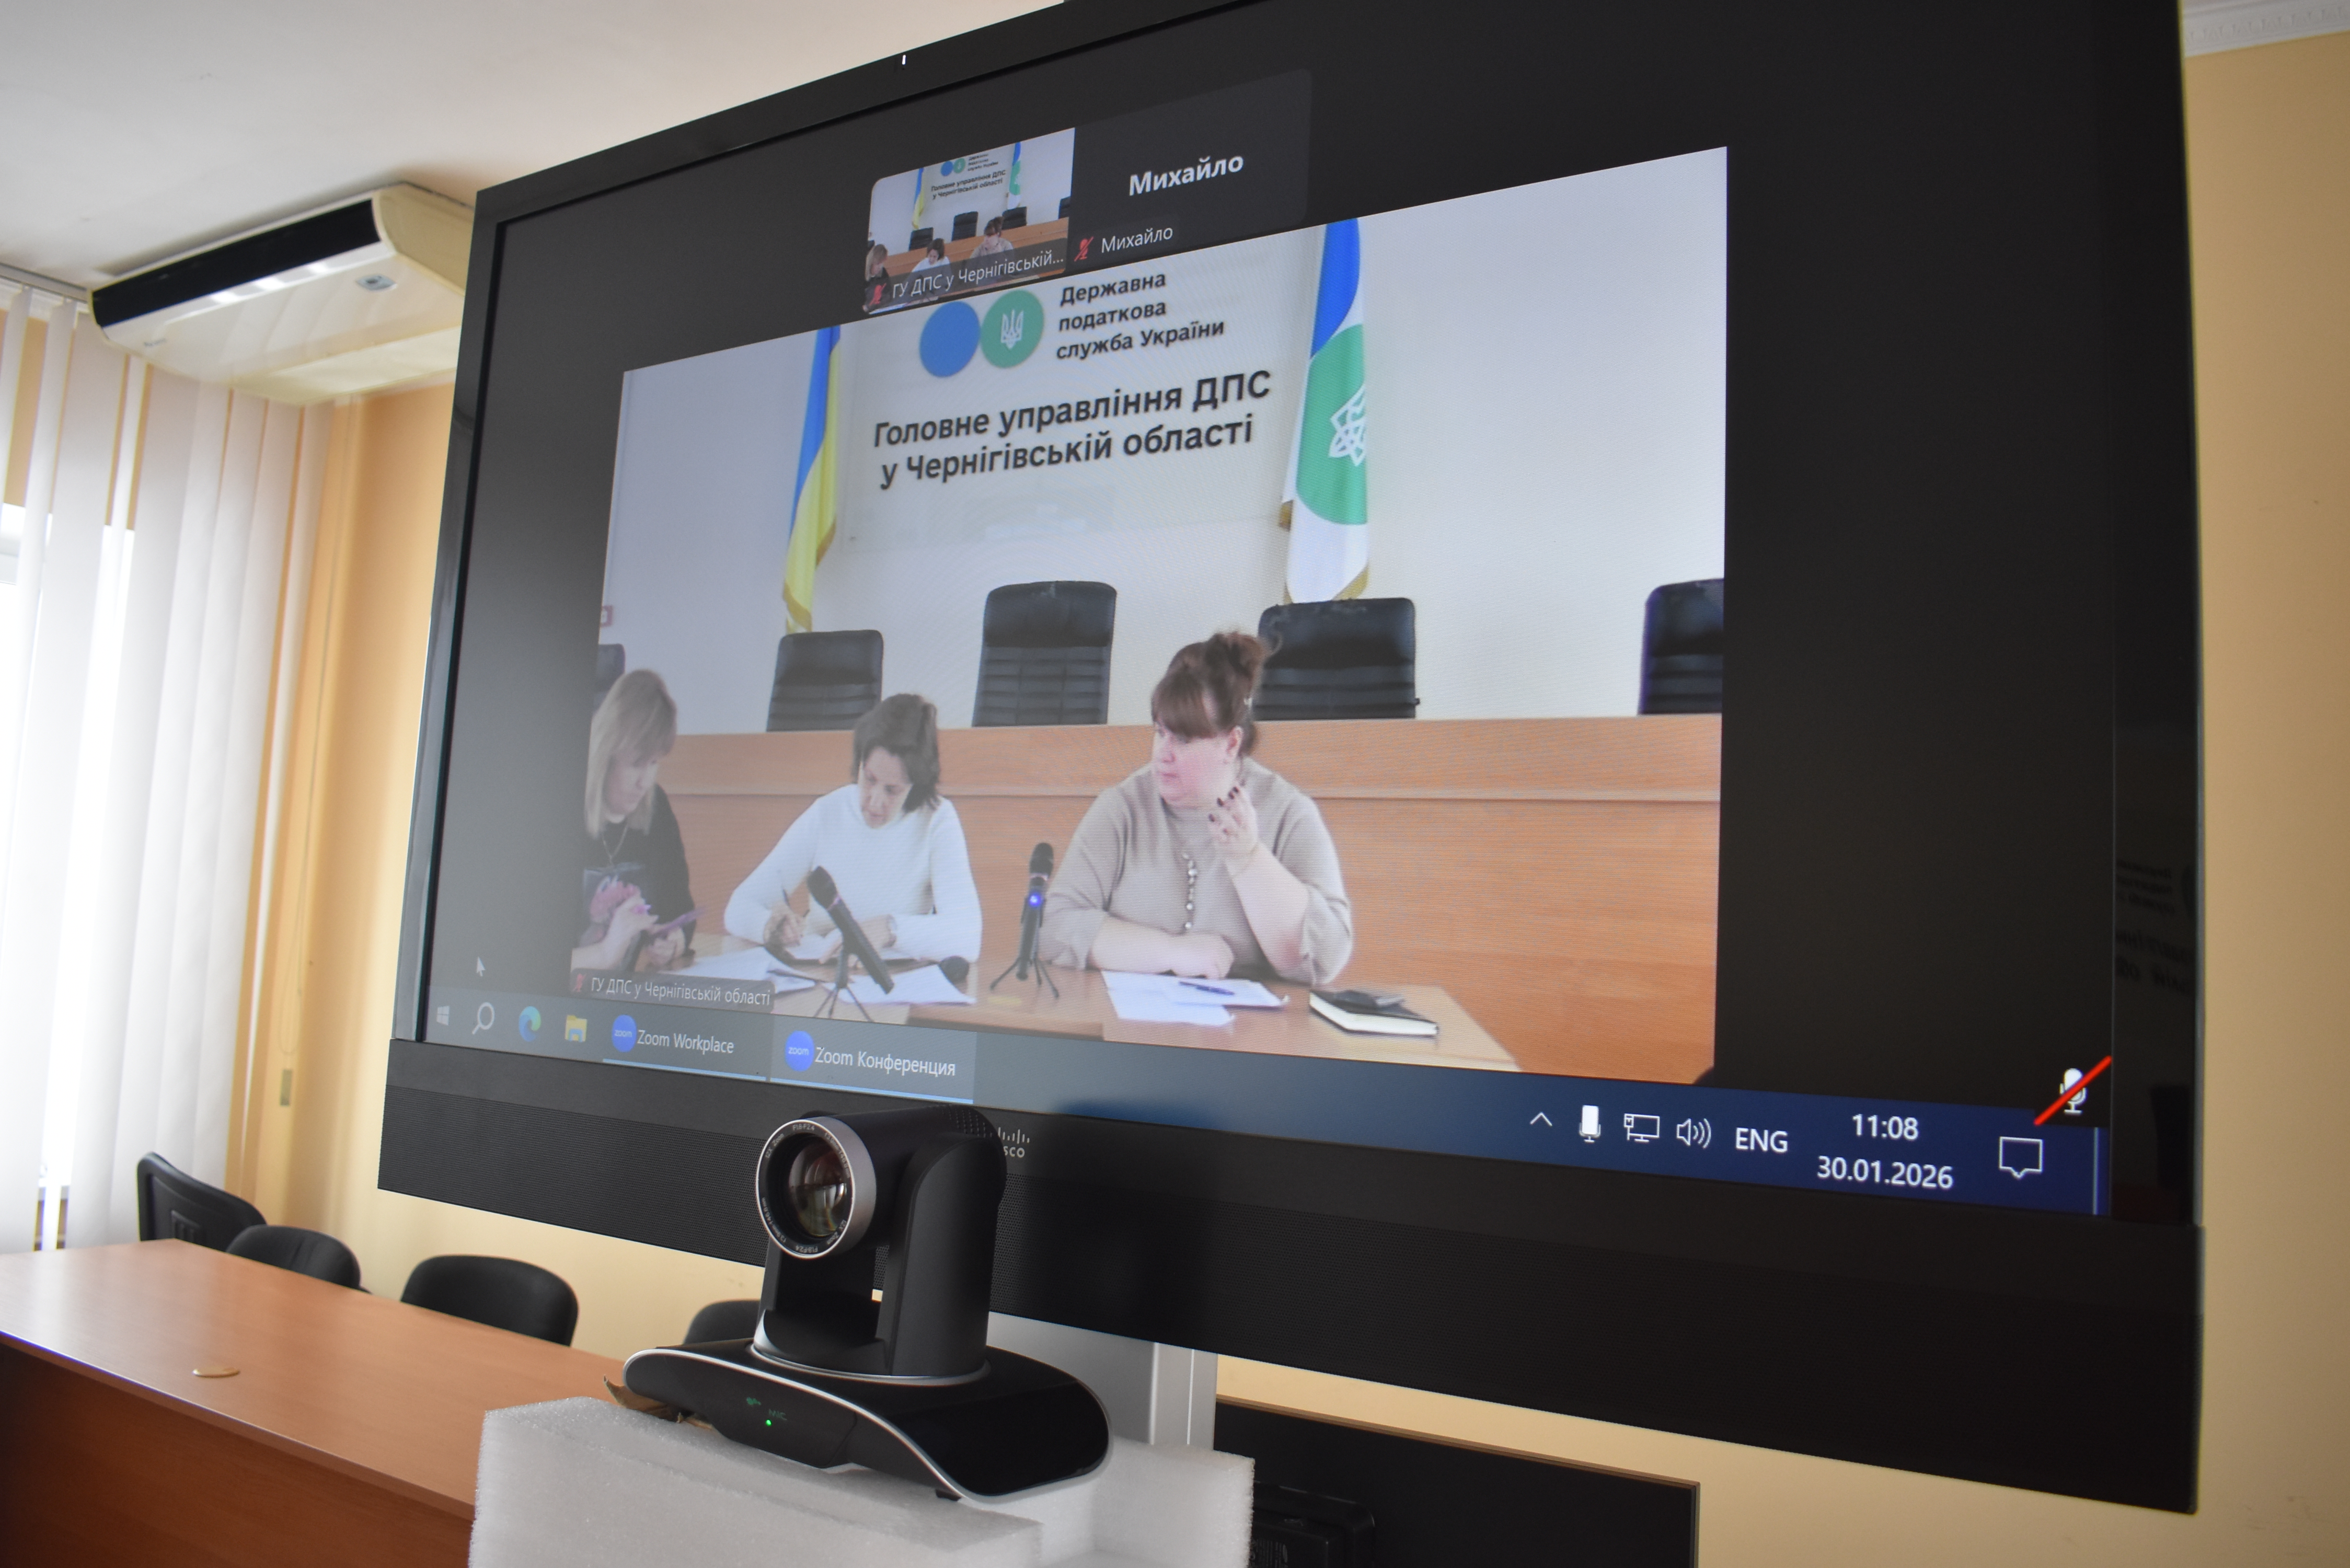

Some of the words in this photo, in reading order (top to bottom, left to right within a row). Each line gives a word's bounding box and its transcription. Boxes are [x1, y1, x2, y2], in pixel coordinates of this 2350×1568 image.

[992, 170, 1006, 179] ДПС
[1129, 156, 1244, 196] Михайло
[1101, 227, 1173, 253] Михайло
[893, 282, 908, 298] ГУ
[911, 274, 942, 296] ДПС
[946, 275, 954, 291] у
[1060, 273, 1166, 306] Державна
[1059, 302, 1166, 331] податкова
[1056, 334, 1133, 360] служба
[1141, 321, 1224, 347] України
[874, 413, 989, 447] Головне
[998, 388, 1182, 437] управління
[1192, 370, 1270, 412] ДПС
[880, 463, 897, 490] у
[907, 430, 1112, 483] Чернігівській
[1123, 413, 1252, 456] області
[591, 977, 605, 991] ГУ
[606, 979, 632, 995] ДПС
[635, 984, 642, 999] у
[645, 982, 721, 1001] Чернігівській
[724, 987, 770, 1006] області
[614, 1030, 632, 1038] zoom
[637, 1029, 670, 1046] Zoom
[674, 1033, 734, 1055] Workplace
[788, 1046, 809, 1056] zoom
[815, 1047, 853, 1066] Zoom
[858, 1051, 955, 1077] Конференция
[1736, 1127, 1788, 1152] ENG
[1852, 1113, 1919, 1140] 11:08
[1817, 1155, 1954, 1190] 30.01.2026
[768, 1409, 788, 1421] MIC
